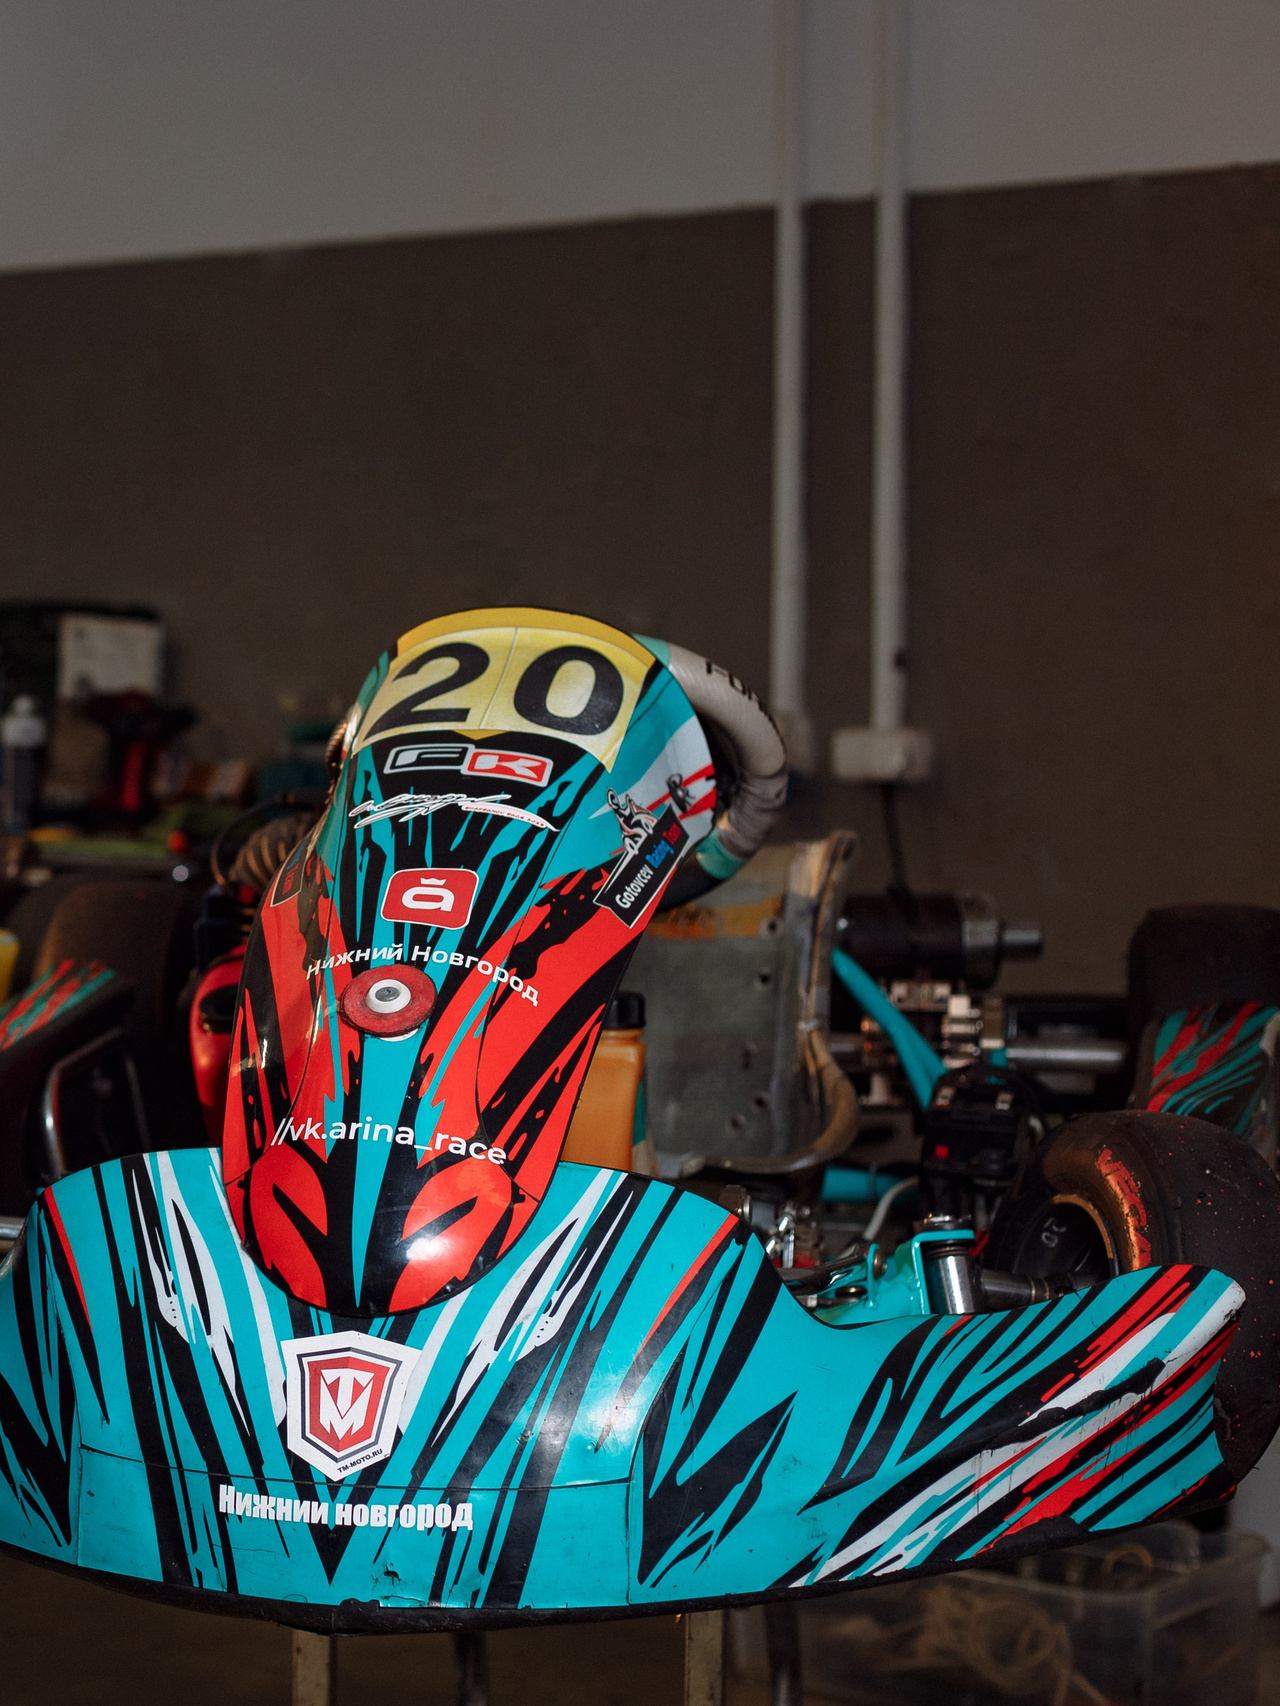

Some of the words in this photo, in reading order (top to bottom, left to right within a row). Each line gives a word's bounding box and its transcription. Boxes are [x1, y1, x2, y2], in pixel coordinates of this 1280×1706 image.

[363, 641, 625, 742] 20
[615, 864, 654, 909] Gotovcev
[645, 840, 675, 869] Racing
[662, 823, 682, 845] Team
[306, 943, 403, 980] Нижний
[411, 945, 539, 1007] Новгород
[270, 1116, 507, 1165] //vk.arina_race
[337, 1448, 383, 1474] TM-MOTO.RU
